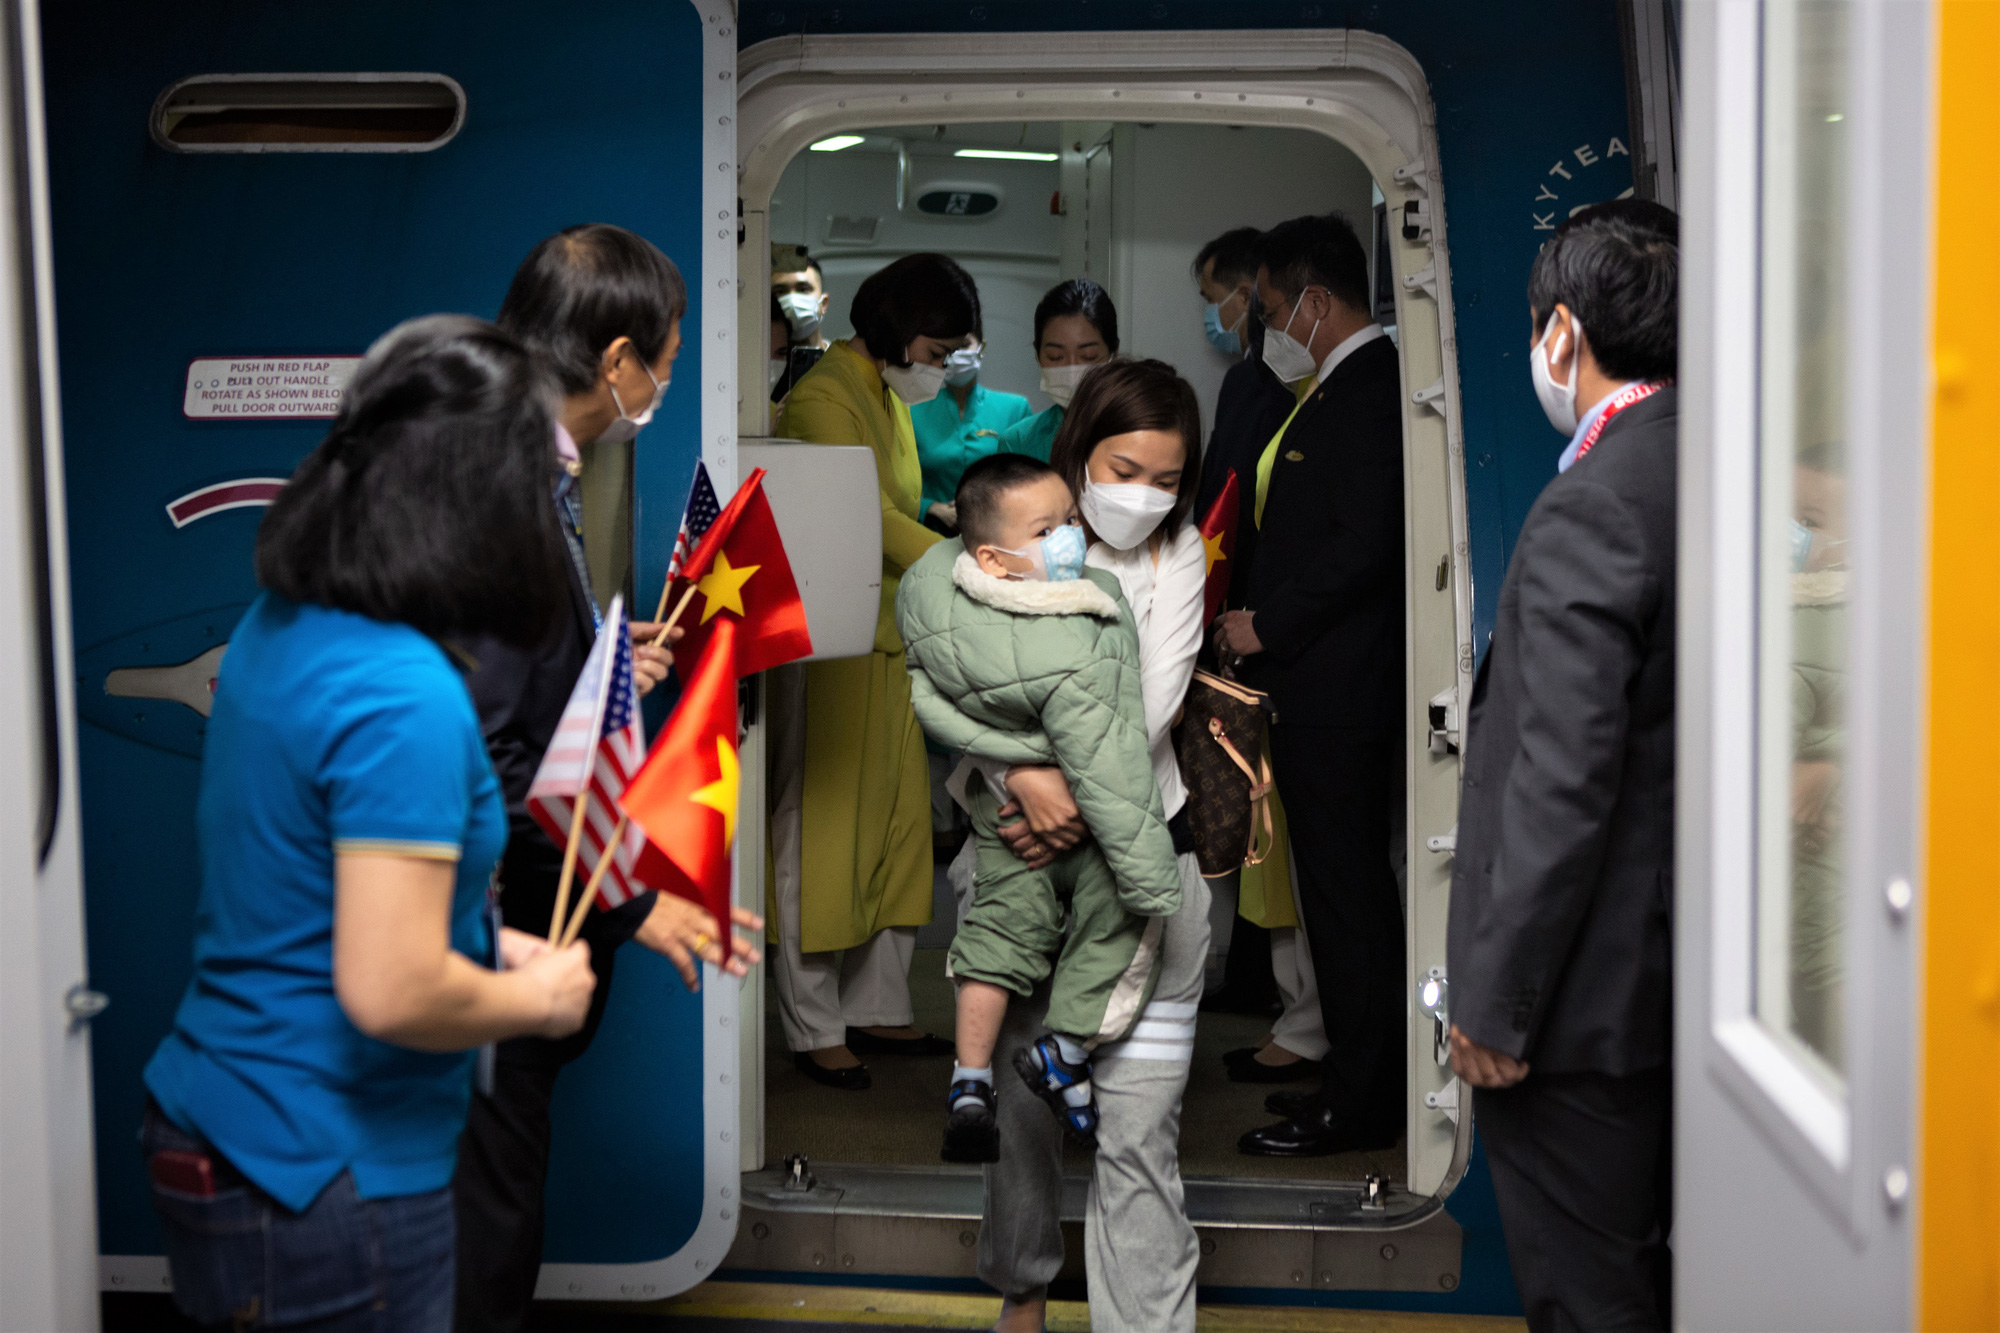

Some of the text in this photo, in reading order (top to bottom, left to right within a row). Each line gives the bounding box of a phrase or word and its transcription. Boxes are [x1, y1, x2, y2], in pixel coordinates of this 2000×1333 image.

[1533, 137, 1629, 253] KYTEA
[230, 362, 330, 373] PUSH IN RED FLAP
[227, 376, 329, 387] PULL OUT HANDLE
[201, 390, 243, 400] ROTATE
[246, 390, 261, 399] AS
[265, 389, 308, 399] SHOWN
[212, 403, 238, 413] PULL
[241, 403, 275, 413] DOOR
